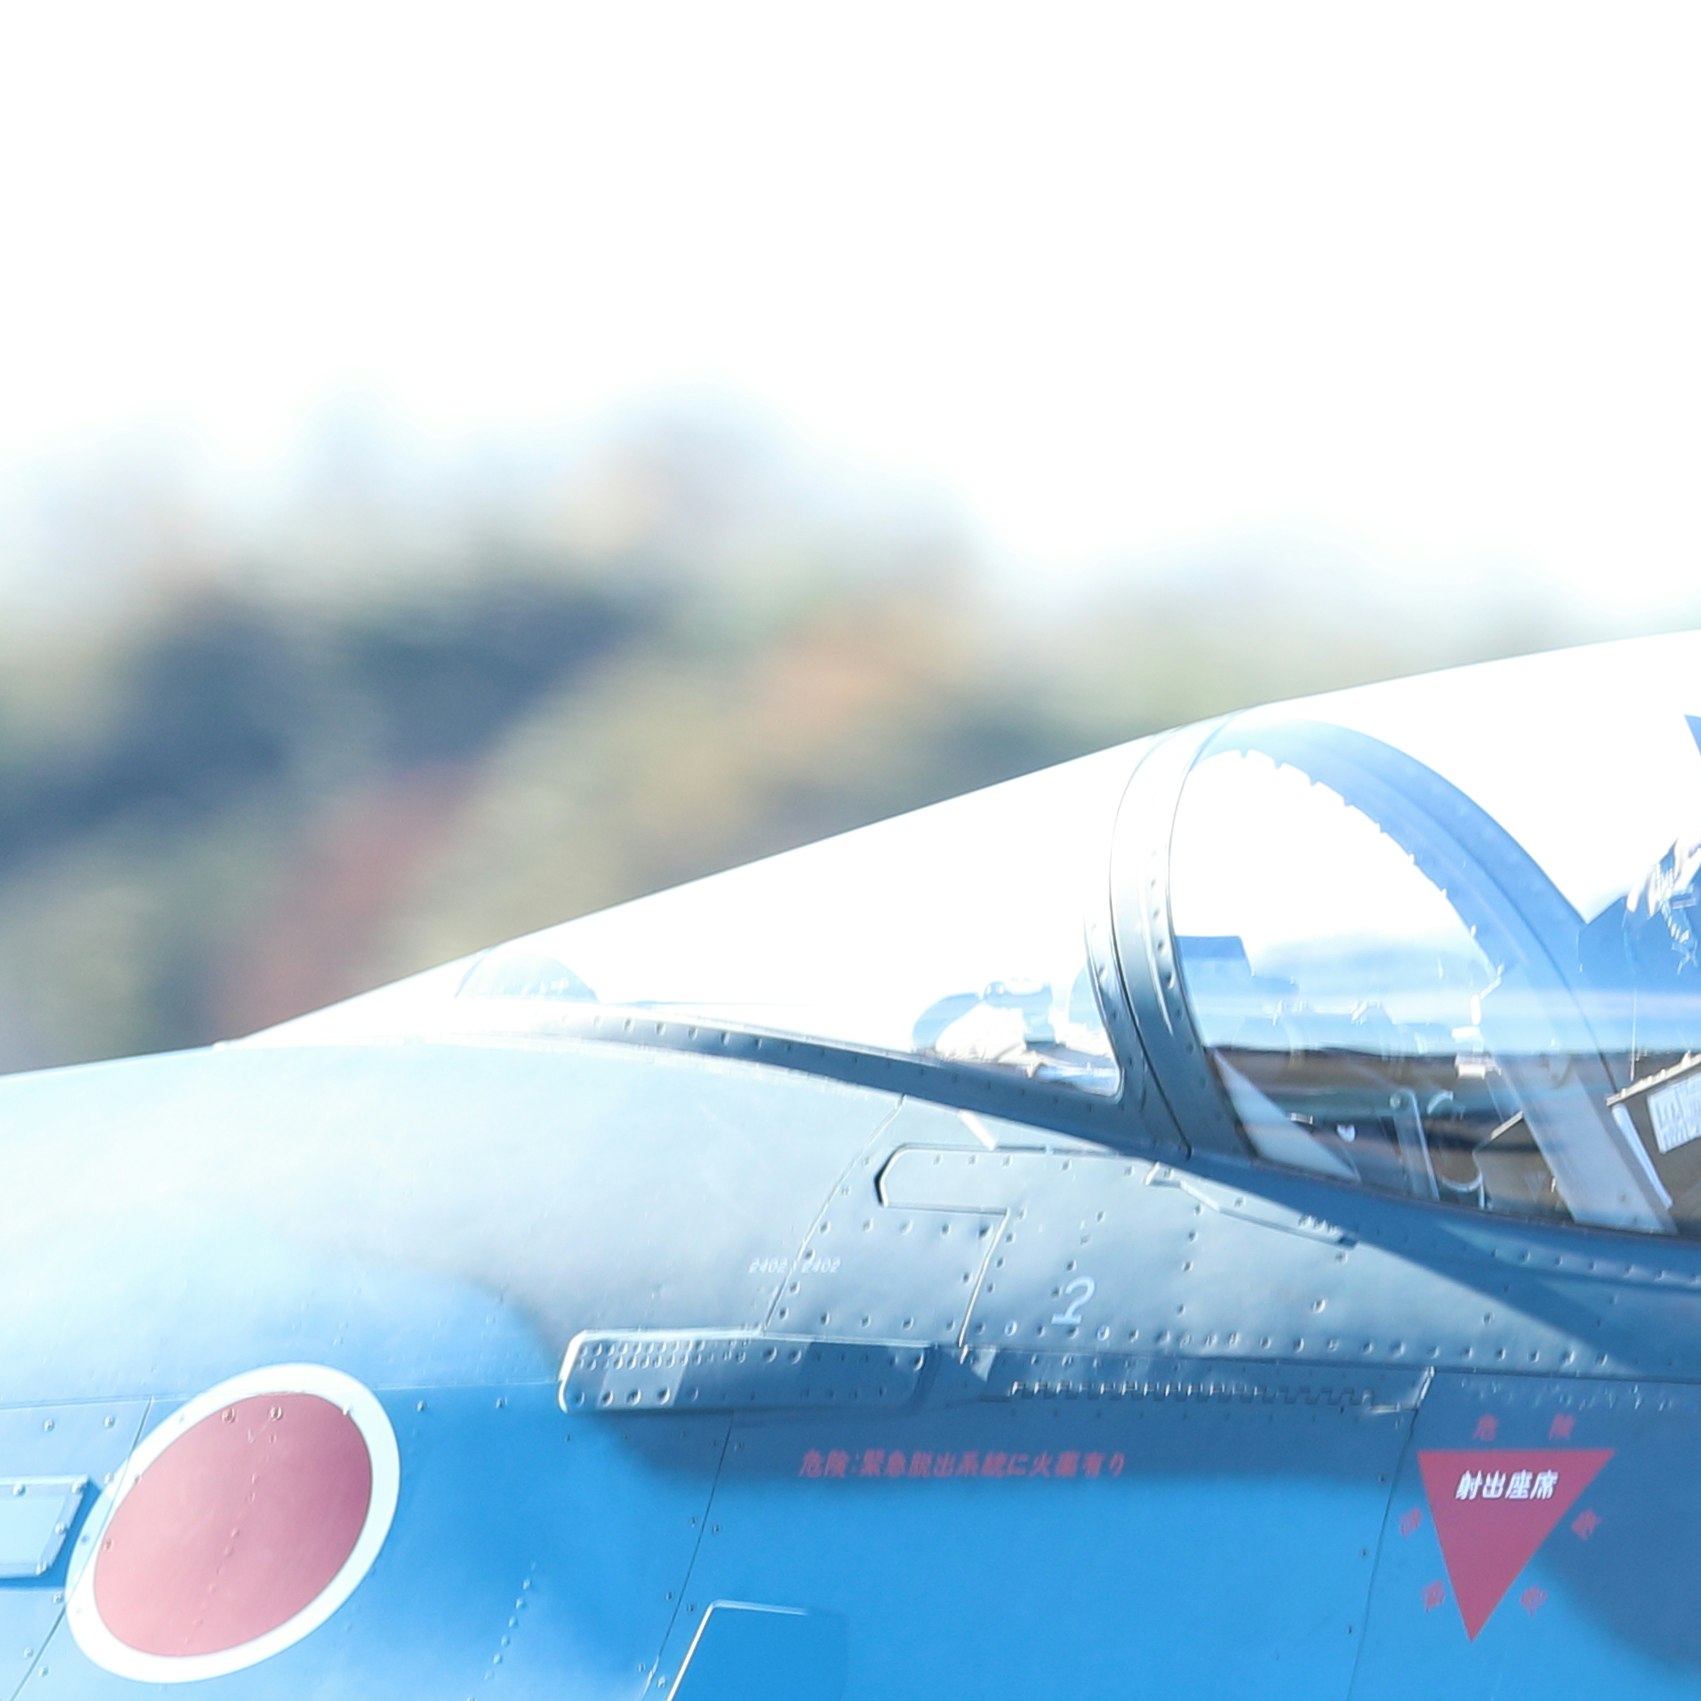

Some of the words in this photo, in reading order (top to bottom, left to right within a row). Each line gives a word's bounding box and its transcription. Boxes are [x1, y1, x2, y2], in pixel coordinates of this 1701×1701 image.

[1051, 1276, 1096, 1326] 2
[1455, 1468, 1559, 1500] 射出座席
